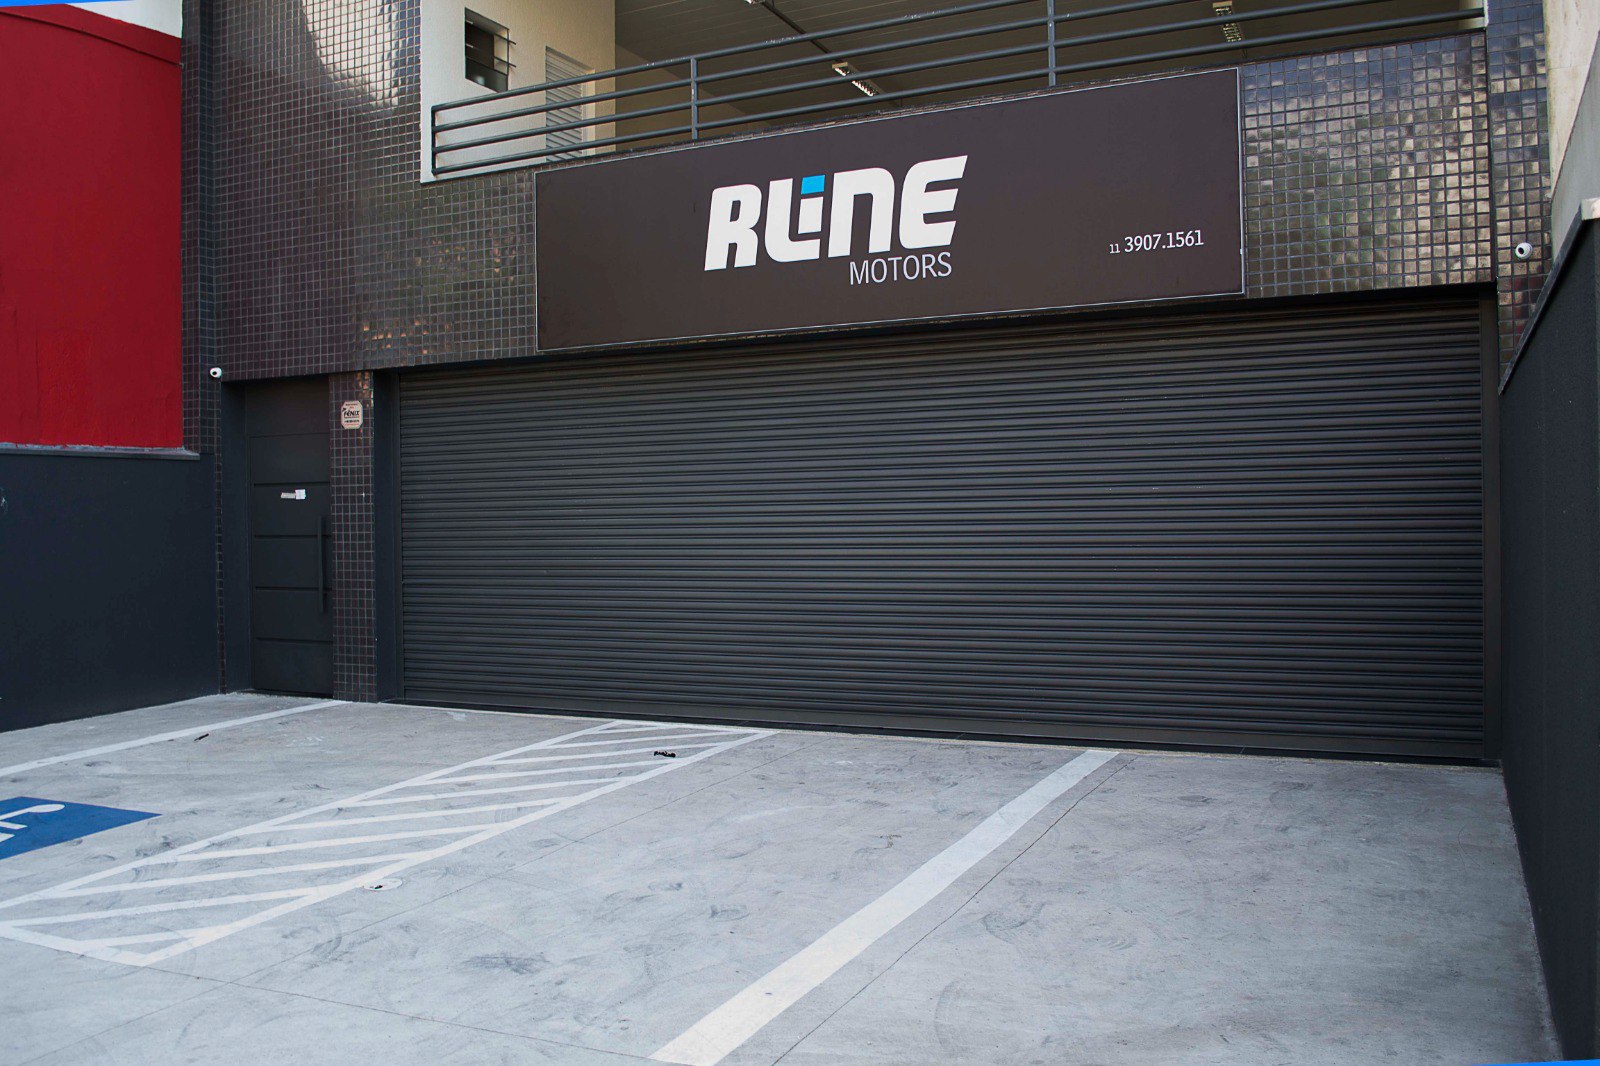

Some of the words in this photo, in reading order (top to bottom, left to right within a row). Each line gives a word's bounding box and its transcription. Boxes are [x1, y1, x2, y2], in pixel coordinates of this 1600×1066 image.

[1109, 243, 1120, 254] 11
[1124, 229, 1204, 253] 3907.1561
[850, 251, 952, 286] MOTORS
